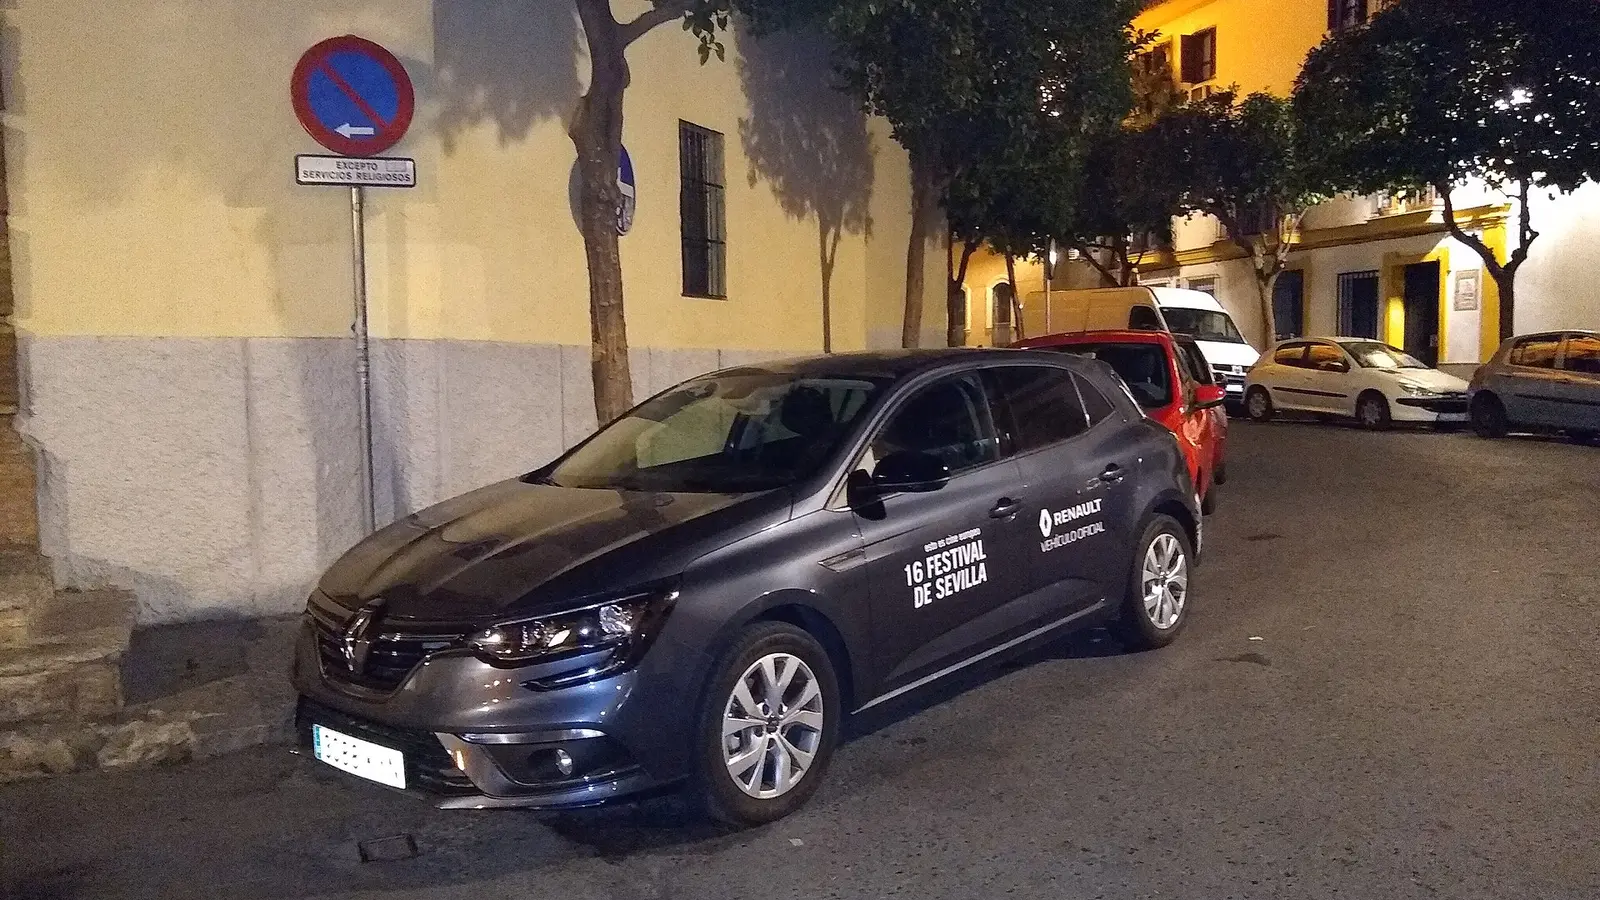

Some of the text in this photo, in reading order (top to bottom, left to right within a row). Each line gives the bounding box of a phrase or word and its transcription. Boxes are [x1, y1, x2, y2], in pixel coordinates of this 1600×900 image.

[302, 169, 411, 182] SERVICIOS RELIGIOSOS
[335, 161, 378, 171] EXCEPTO
[1053, 498, 1103, 526] RENAULT
[1077, 521, 1106, 540] OFICIAL
[904, 539, 987, 587] 16 FESTIVAL
[914, 562, 988, 609] DE SEVILLA
